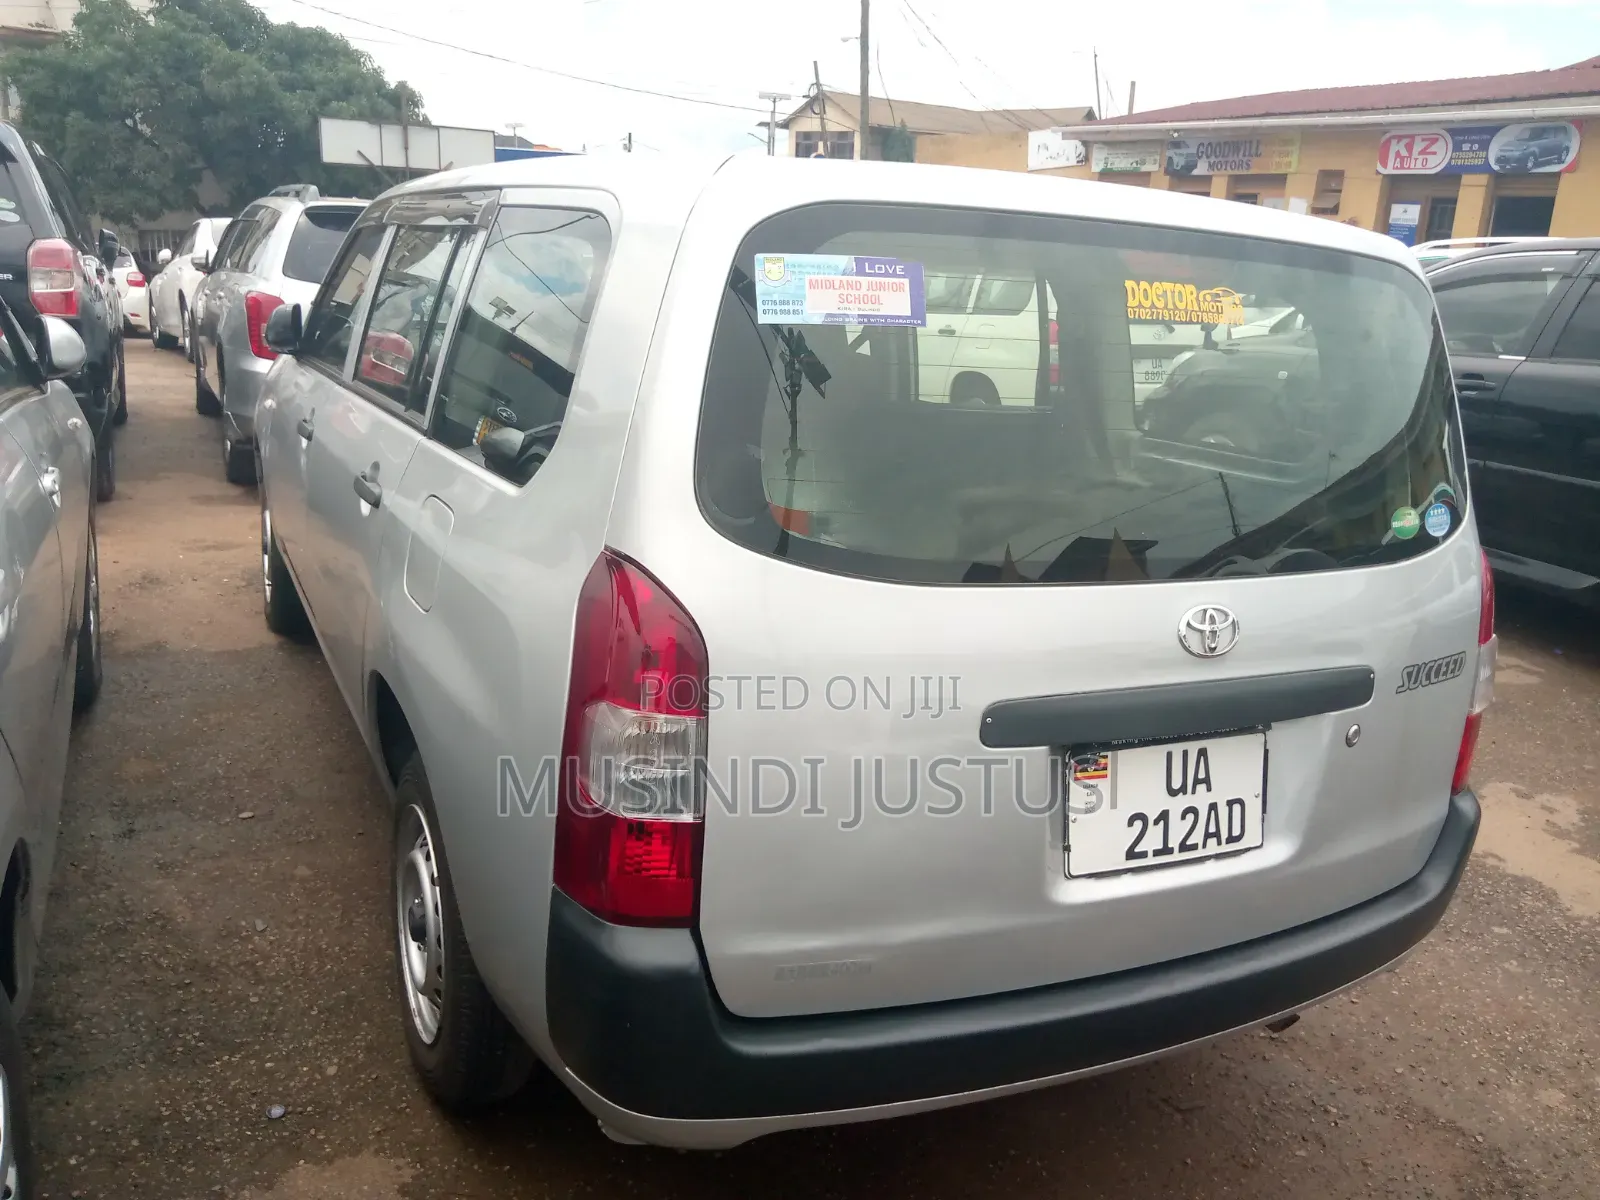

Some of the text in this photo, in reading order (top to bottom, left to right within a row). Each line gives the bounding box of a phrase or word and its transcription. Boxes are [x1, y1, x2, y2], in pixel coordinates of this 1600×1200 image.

[1196, 139, 1262, 159] GOODWILL
[1207, 159, 1251, 171] MOTORS
[1394, 157, 1428, 168] AUTO
[864, 262, 905, 275] LOVE
[808, 278, 906, 293] MIDLAND JUNIOR
[838, 293, 883, 306] SCHOOL
[1125, 280, 1199, 311] DOCTOR
[1396, 651, 1466, 694] SUCCEED
[1165, 747, 1212, 797] UA
[1125, 797, 1246, 861] 212AD
